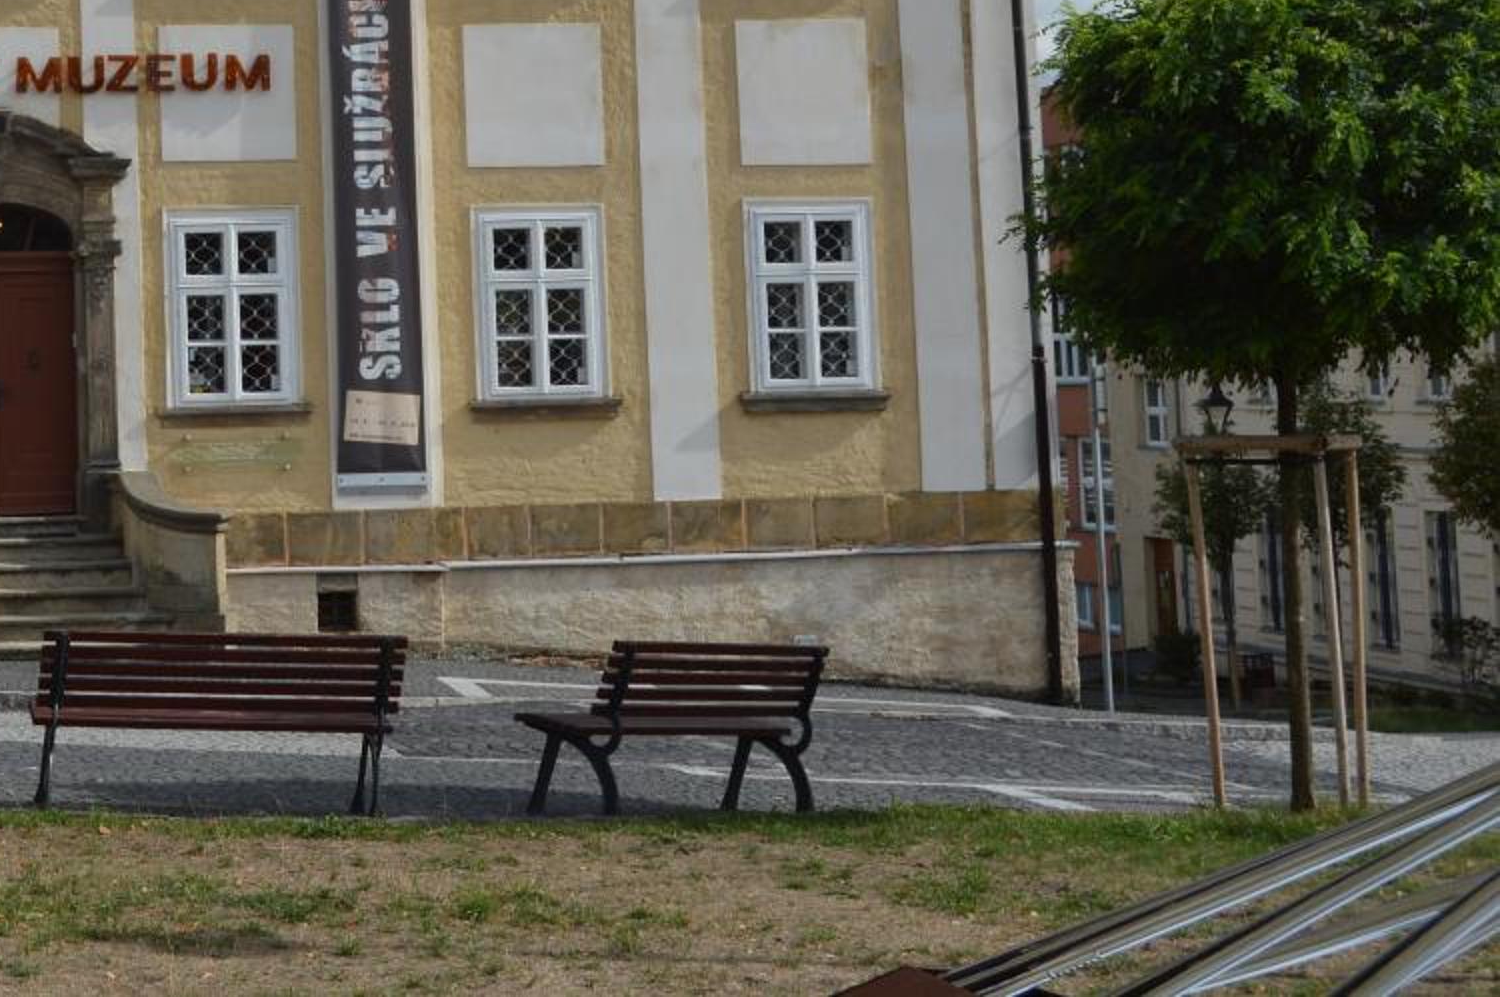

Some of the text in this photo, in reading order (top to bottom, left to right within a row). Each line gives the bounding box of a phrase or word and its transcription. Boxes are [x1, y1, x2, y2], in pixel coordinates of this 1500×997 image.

[15, 53, 271, 93] MUZEUM
[355, 207, 397, 258] VE
[357, 277, 402, 380] SKLO
